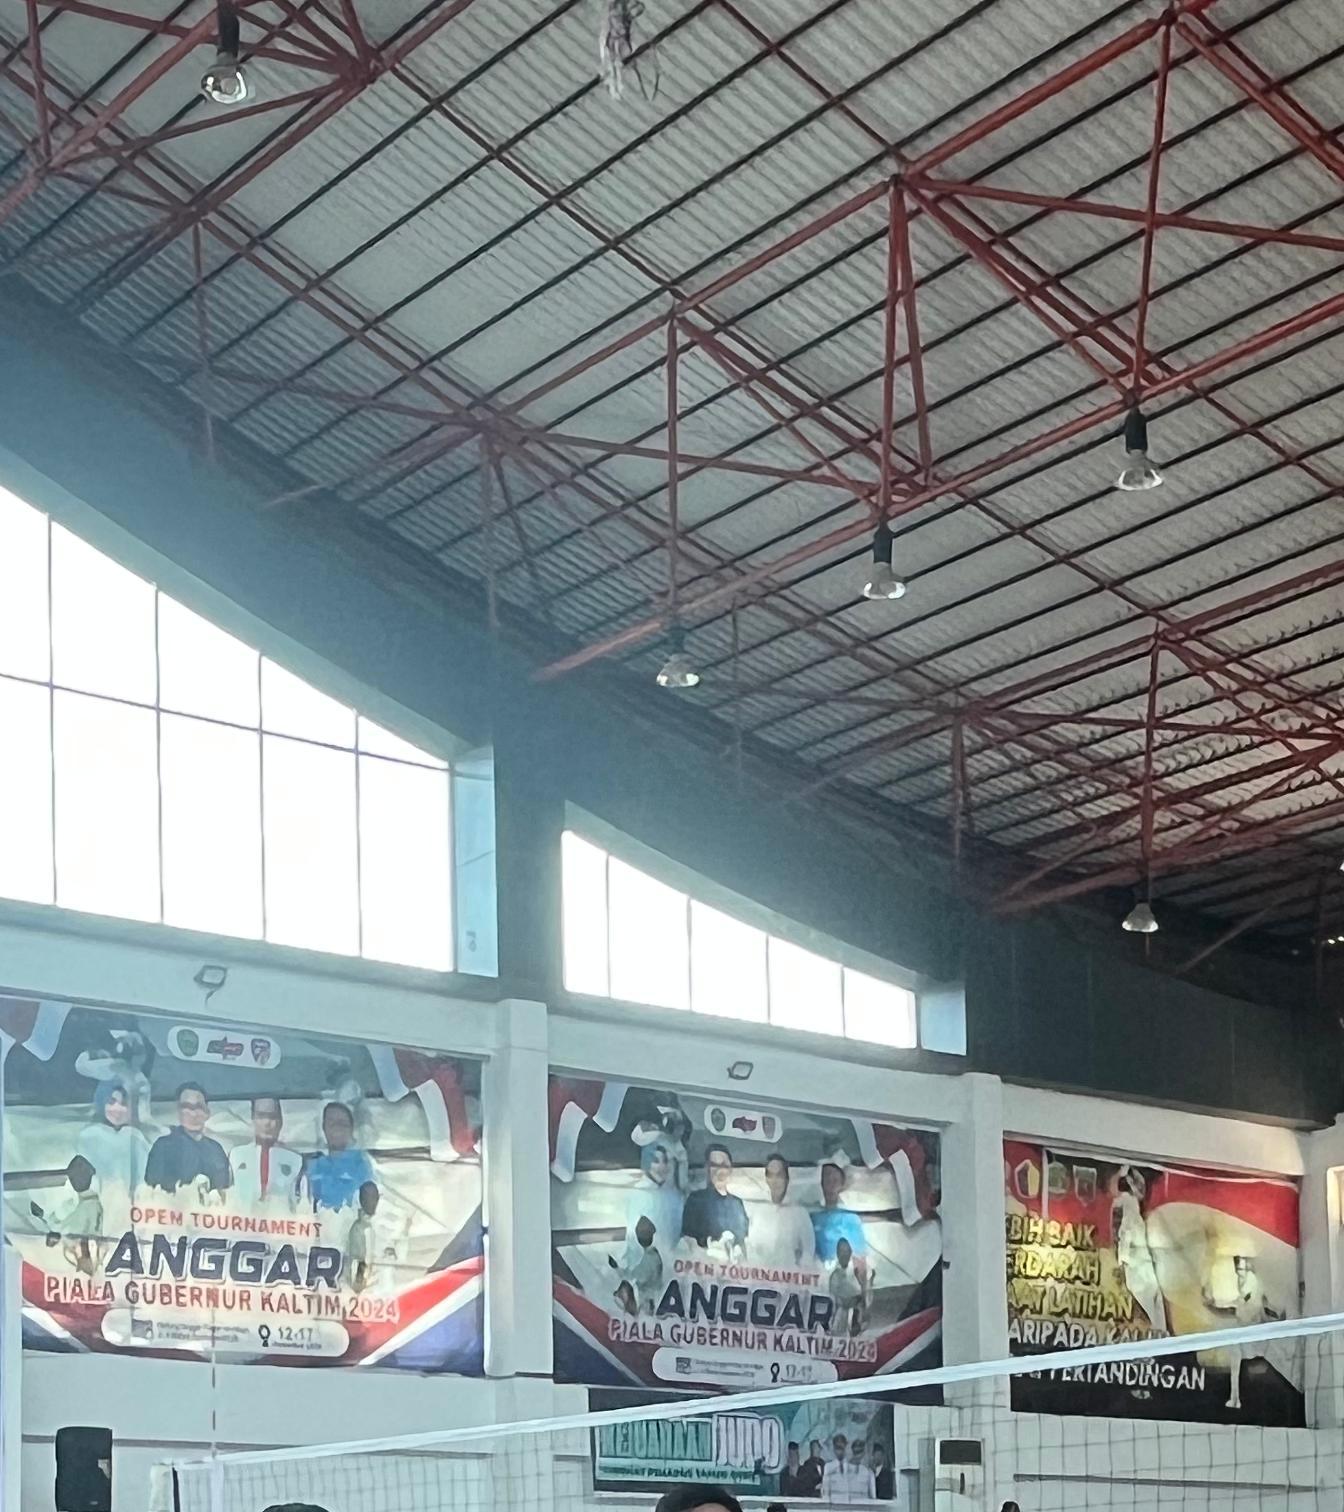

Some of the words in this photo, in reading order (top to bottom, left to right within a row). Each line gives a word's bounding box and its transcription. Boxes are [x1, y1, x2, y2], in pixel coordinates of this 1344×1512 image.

[130, 1206, 183, 1227] OPEN
[191, 1213, 322, 1238] TOURNAMENT
[1045, 1220, 1095, 1249] BAIK
[105, 1230, 343, 1289] ANGGAR
[674, 1259, 715, 1276] OPEN
[719, 1264, 821, 1286] TOURNAMENT
[46, 1275, 116, 1302] PIALA
[125, 1281, 251, 1311] GUBERNUR
[261, 1290, 342, 1320] KALTIM
[349, 1297, 400, 1321] 2024
[656, 1278, 834, 1332] ANGGAR
[1048, 1286, 1133, 1320] LATIHAN
[610, 1318, 664, 1341] PIALA
[670, 1324, 767, 1351] GUBERNUR
[774, 1332, 834, 1358] KALTIM
